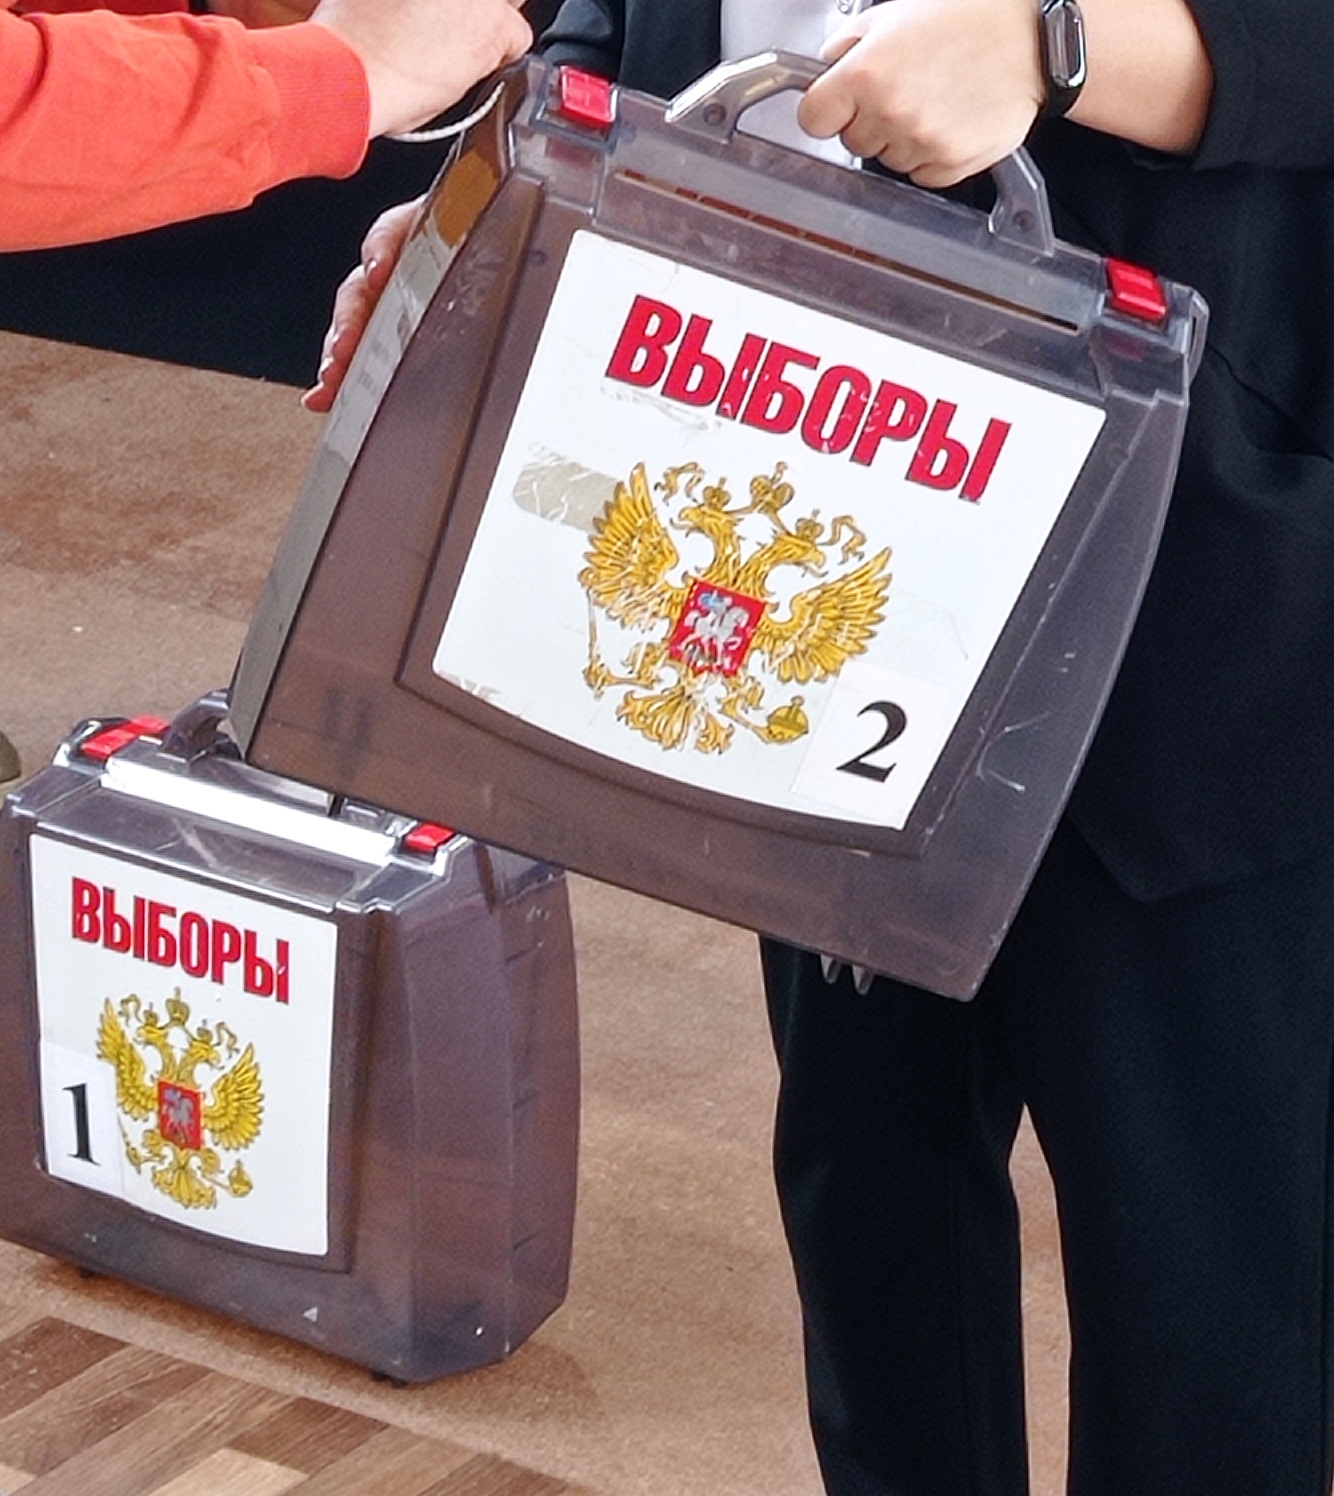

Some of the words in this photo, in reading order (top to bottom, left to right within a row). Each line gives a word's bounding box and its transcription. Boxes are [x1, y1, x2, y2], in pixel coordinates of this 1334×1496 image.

[604, 294, 1011, 504] ВЫБОРЫ
[836, 699, 908, 783] 2
[70, 875, 290, 1004] ВЫБОРЫ
[61, 1081, 102, 1167] 1
